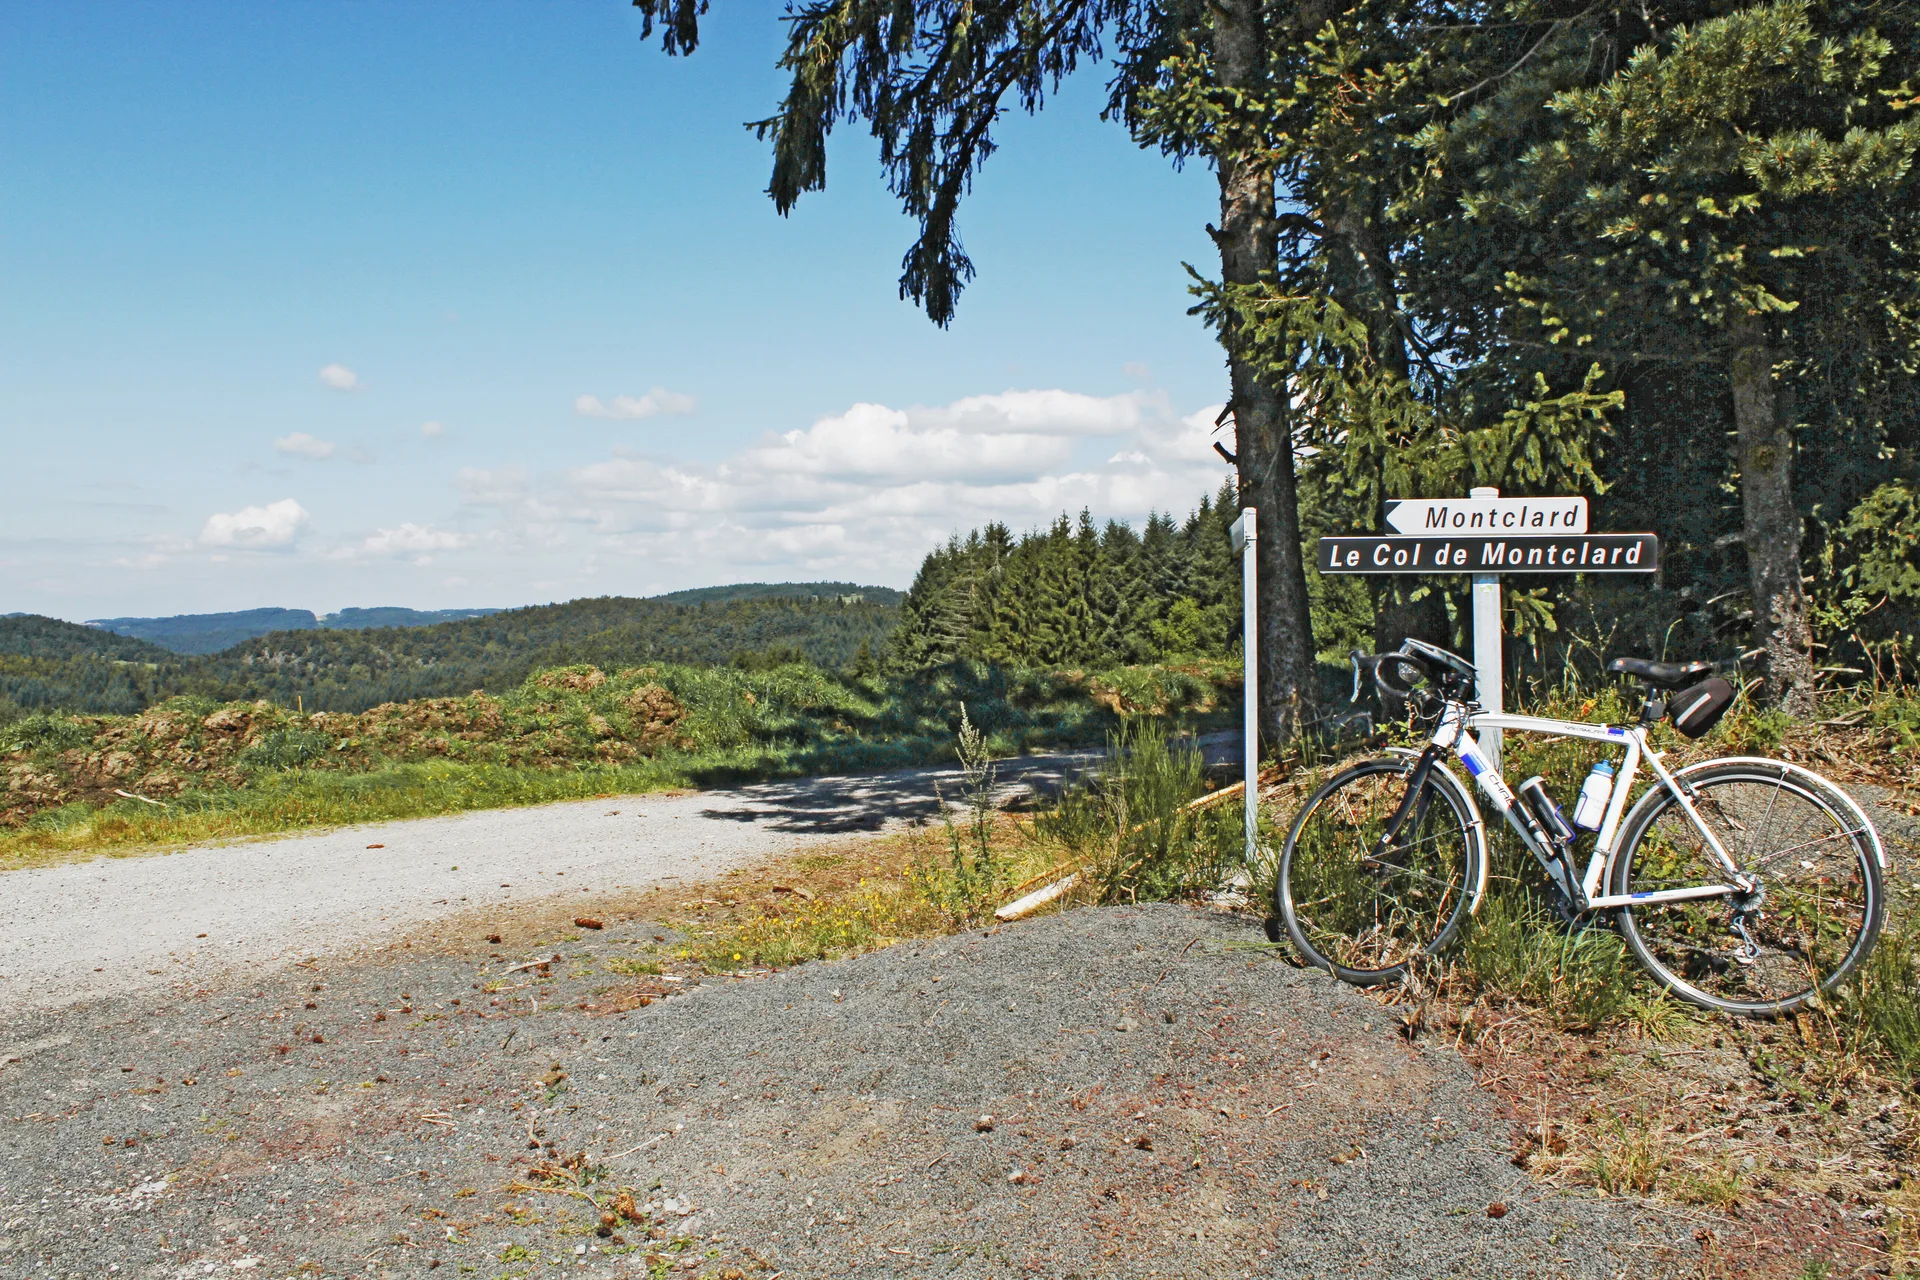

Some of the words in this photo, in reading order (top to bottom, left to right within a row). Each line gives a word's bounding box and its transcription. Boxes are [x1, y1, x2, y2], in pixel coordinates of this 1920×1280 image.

[1425, 504, 1579, 528] Montclard
[1330, 544, 1360, 567] Le
[1373, 543, 1421, 566] Col
[1434, 542, 1467, 566] de
[1481, 541, 1643, 565] Montclard
